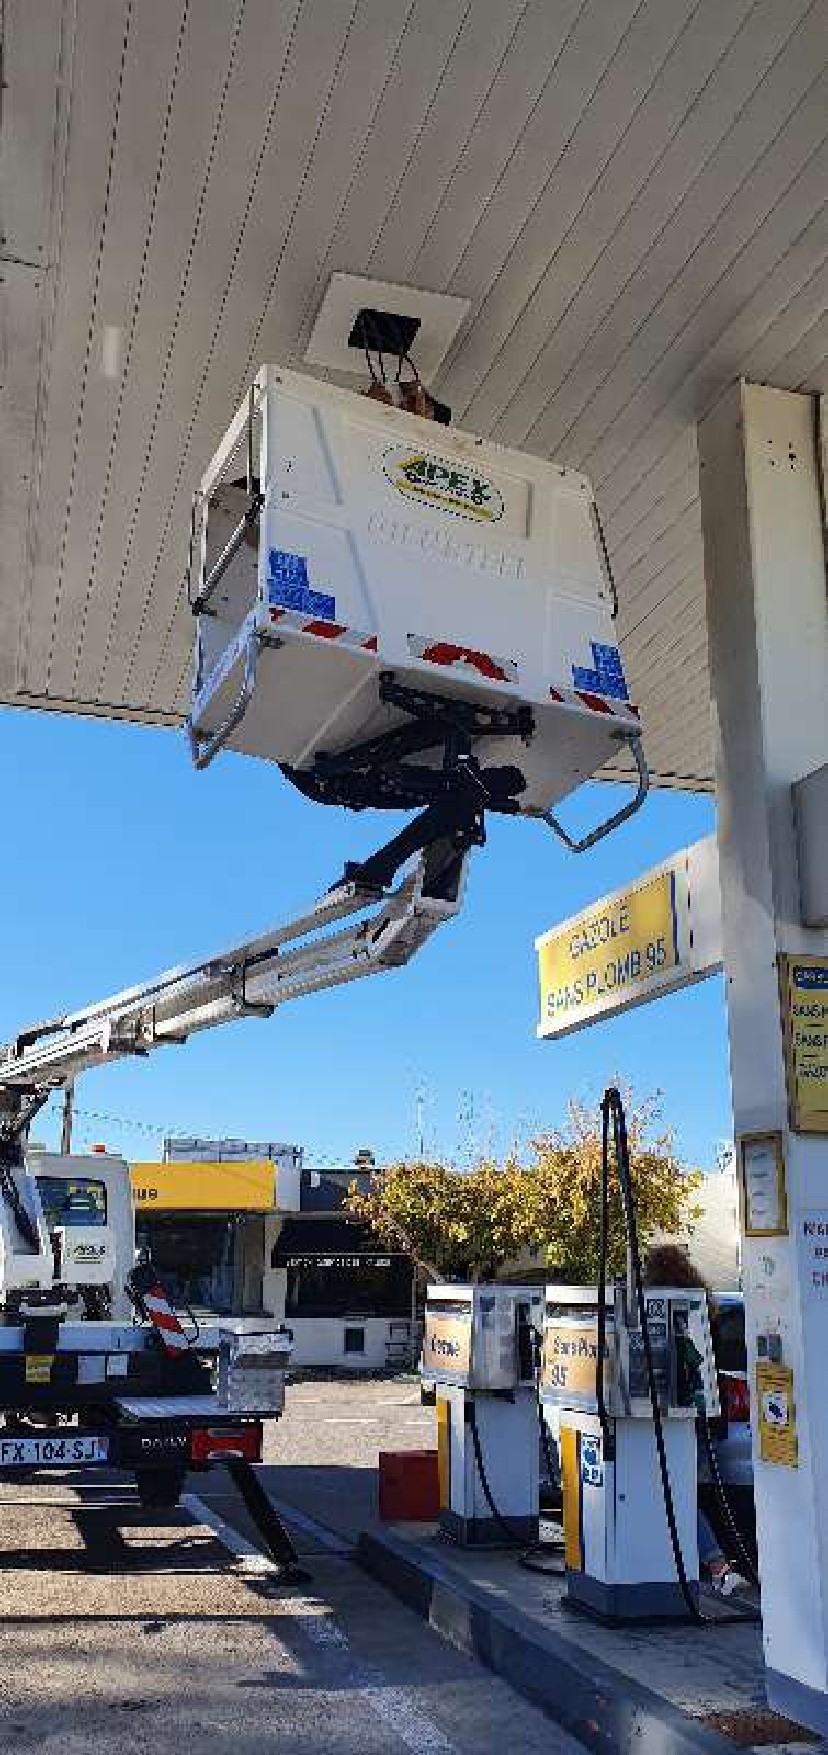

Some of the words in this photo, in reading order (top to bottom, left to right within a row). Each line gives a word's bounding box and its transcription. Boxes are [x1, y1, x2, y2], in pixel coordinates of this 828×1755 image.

[403, 459, 492, 501] APEX
[547, 980, 584, 1017] SANS
[586, 949, 641, 999] PLOMB
[646, 937, 667, 971] 95
[551, 1364, 568, 1387] 95
